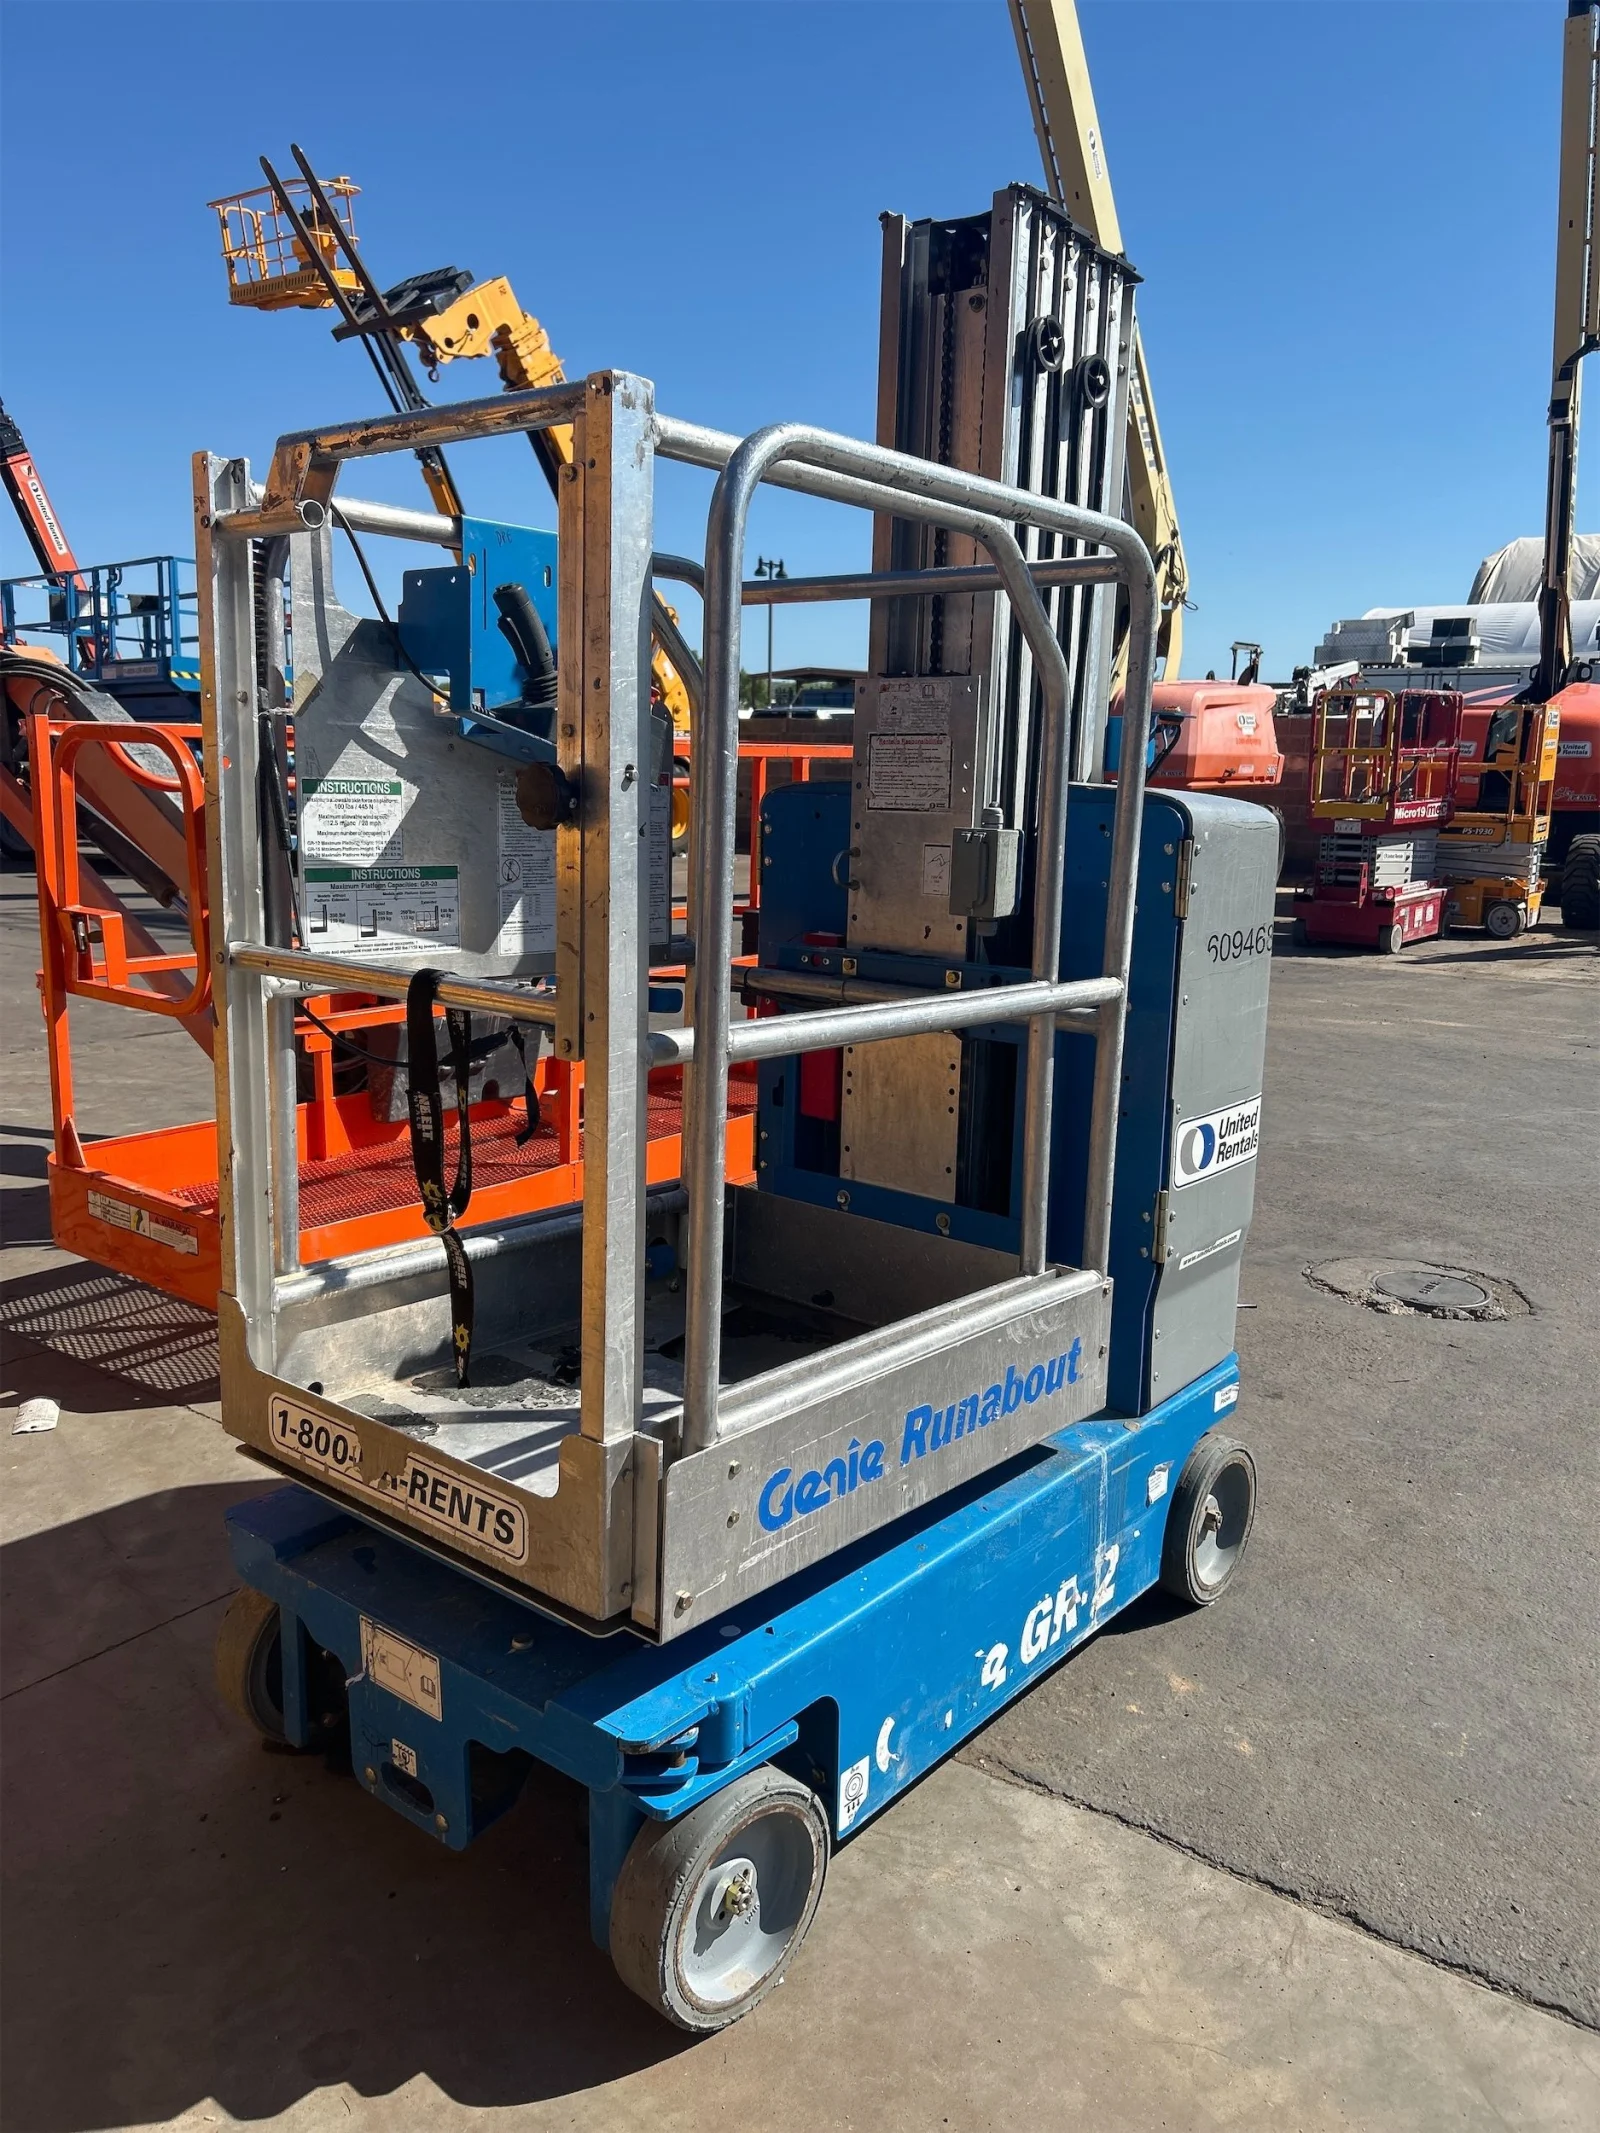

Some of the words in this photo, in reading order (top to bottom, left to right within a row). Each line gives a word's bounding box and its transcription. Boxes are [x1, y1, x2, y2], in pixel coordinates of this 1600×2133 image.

[35, 494, 52, 521] United
[47, 522, 64, 551] Rentals
[317, 781, 391, 794] INSTRUCTIONS
[1394, 806, 1426, 820] Micro19
[351, 868, 421, 880] INSTRUCTIONS
[1218, 1105, 1259, 1140] United
[1216, 1131, 1259, 1165] Rentals
[757, 1438, 886, 1532] Genie
[901, 1336, 1083, 1468] Runabout
